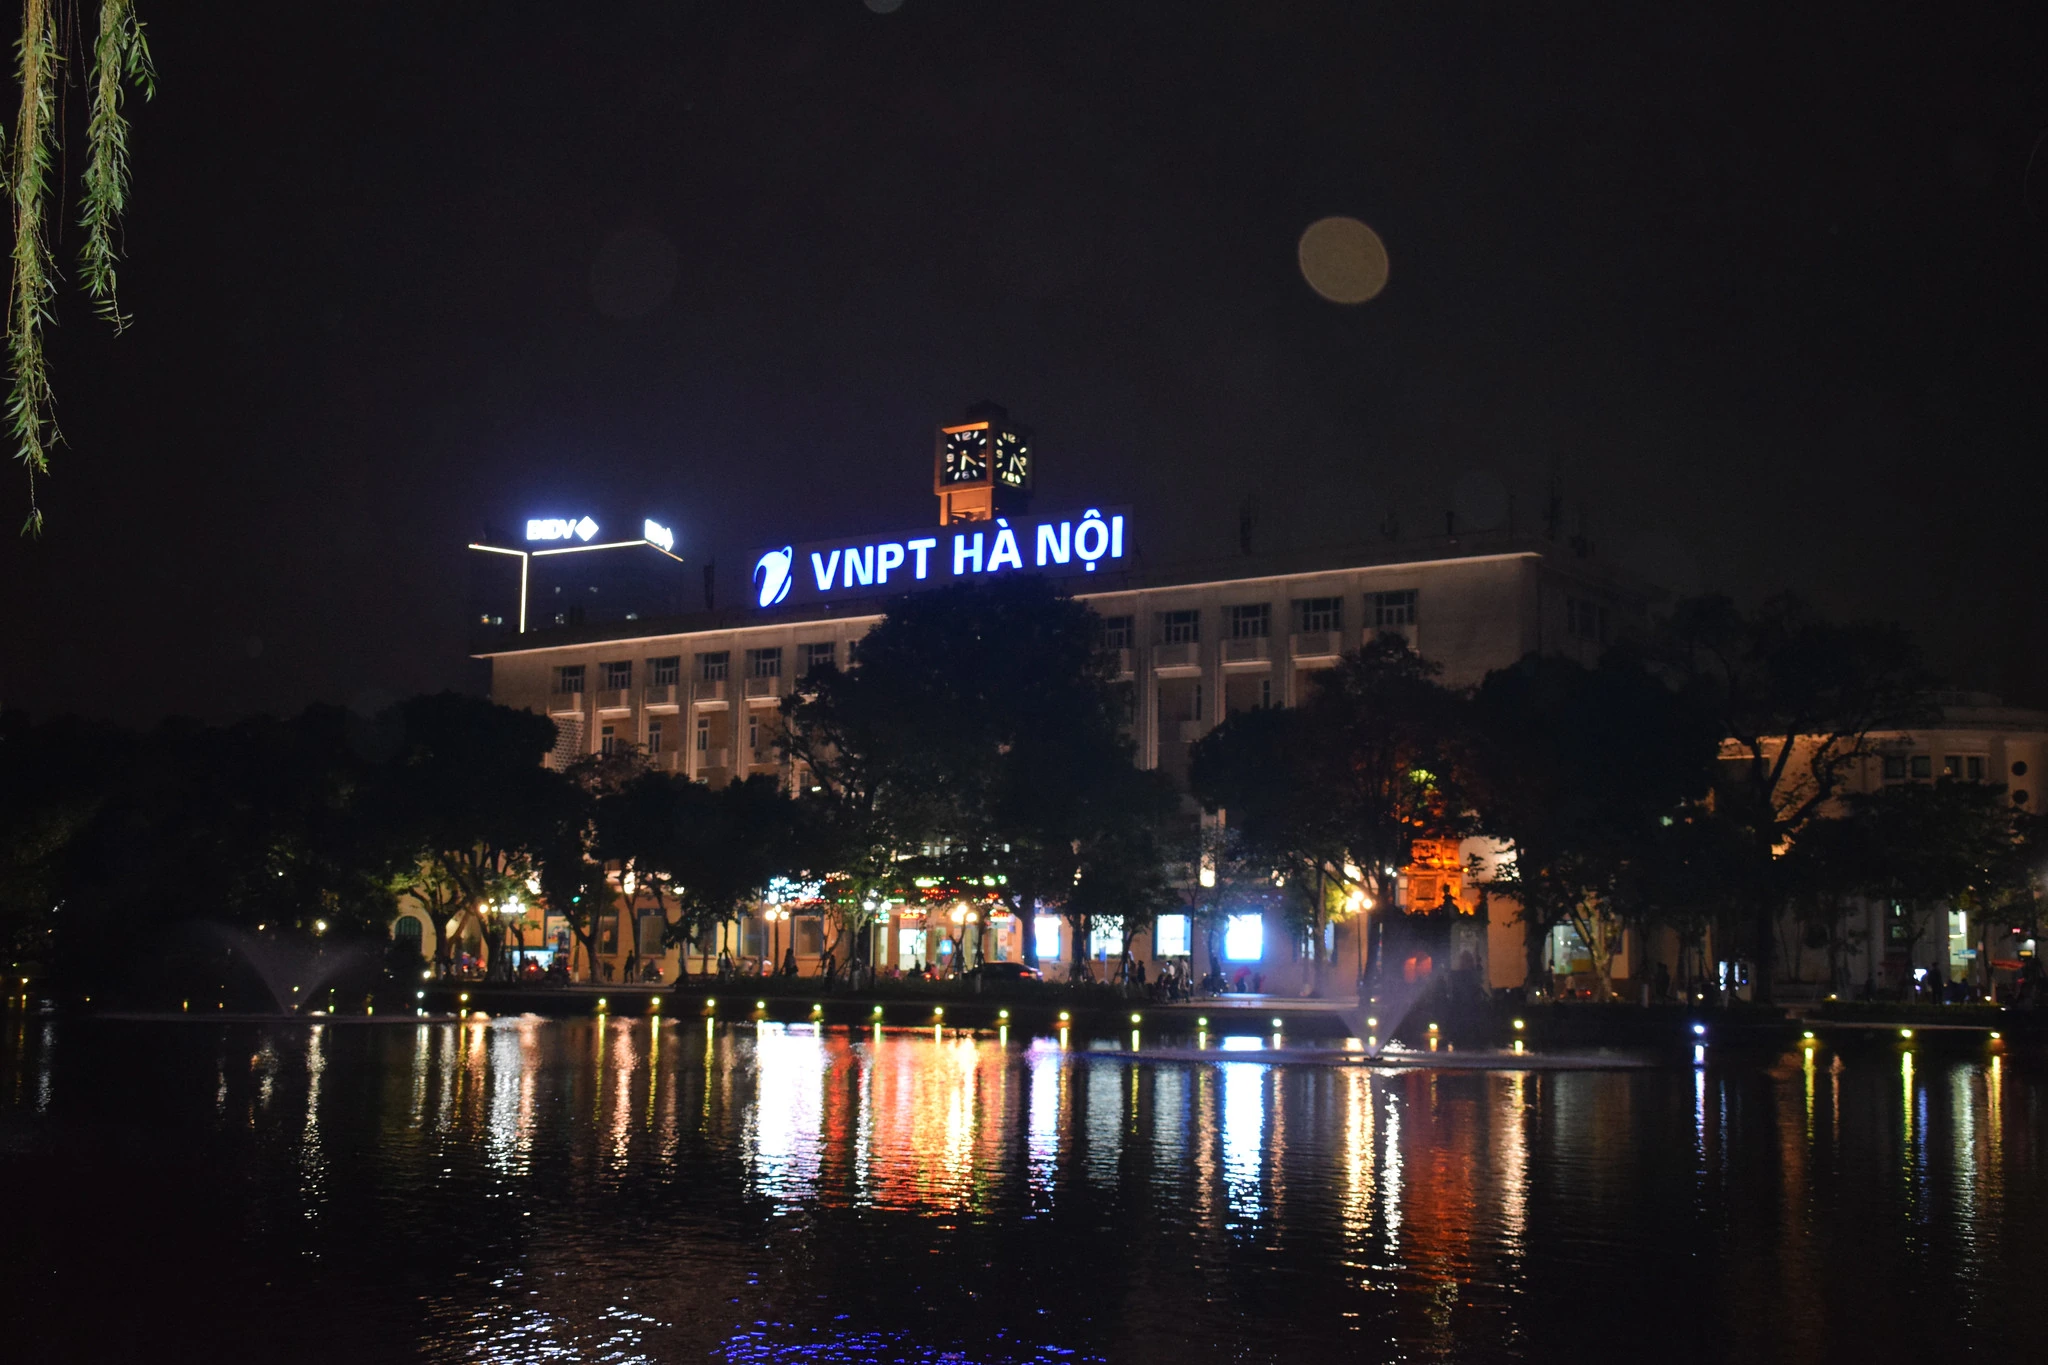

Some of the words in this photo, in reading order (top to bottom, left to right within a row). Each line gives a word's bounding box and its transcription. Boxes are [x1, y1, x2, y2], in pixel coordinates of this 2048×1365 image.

[811, 537, 936, 591] VNPT
[952, 518, 1023, 576] HÀ
[1036, 508, 1124, 572] NỘI
